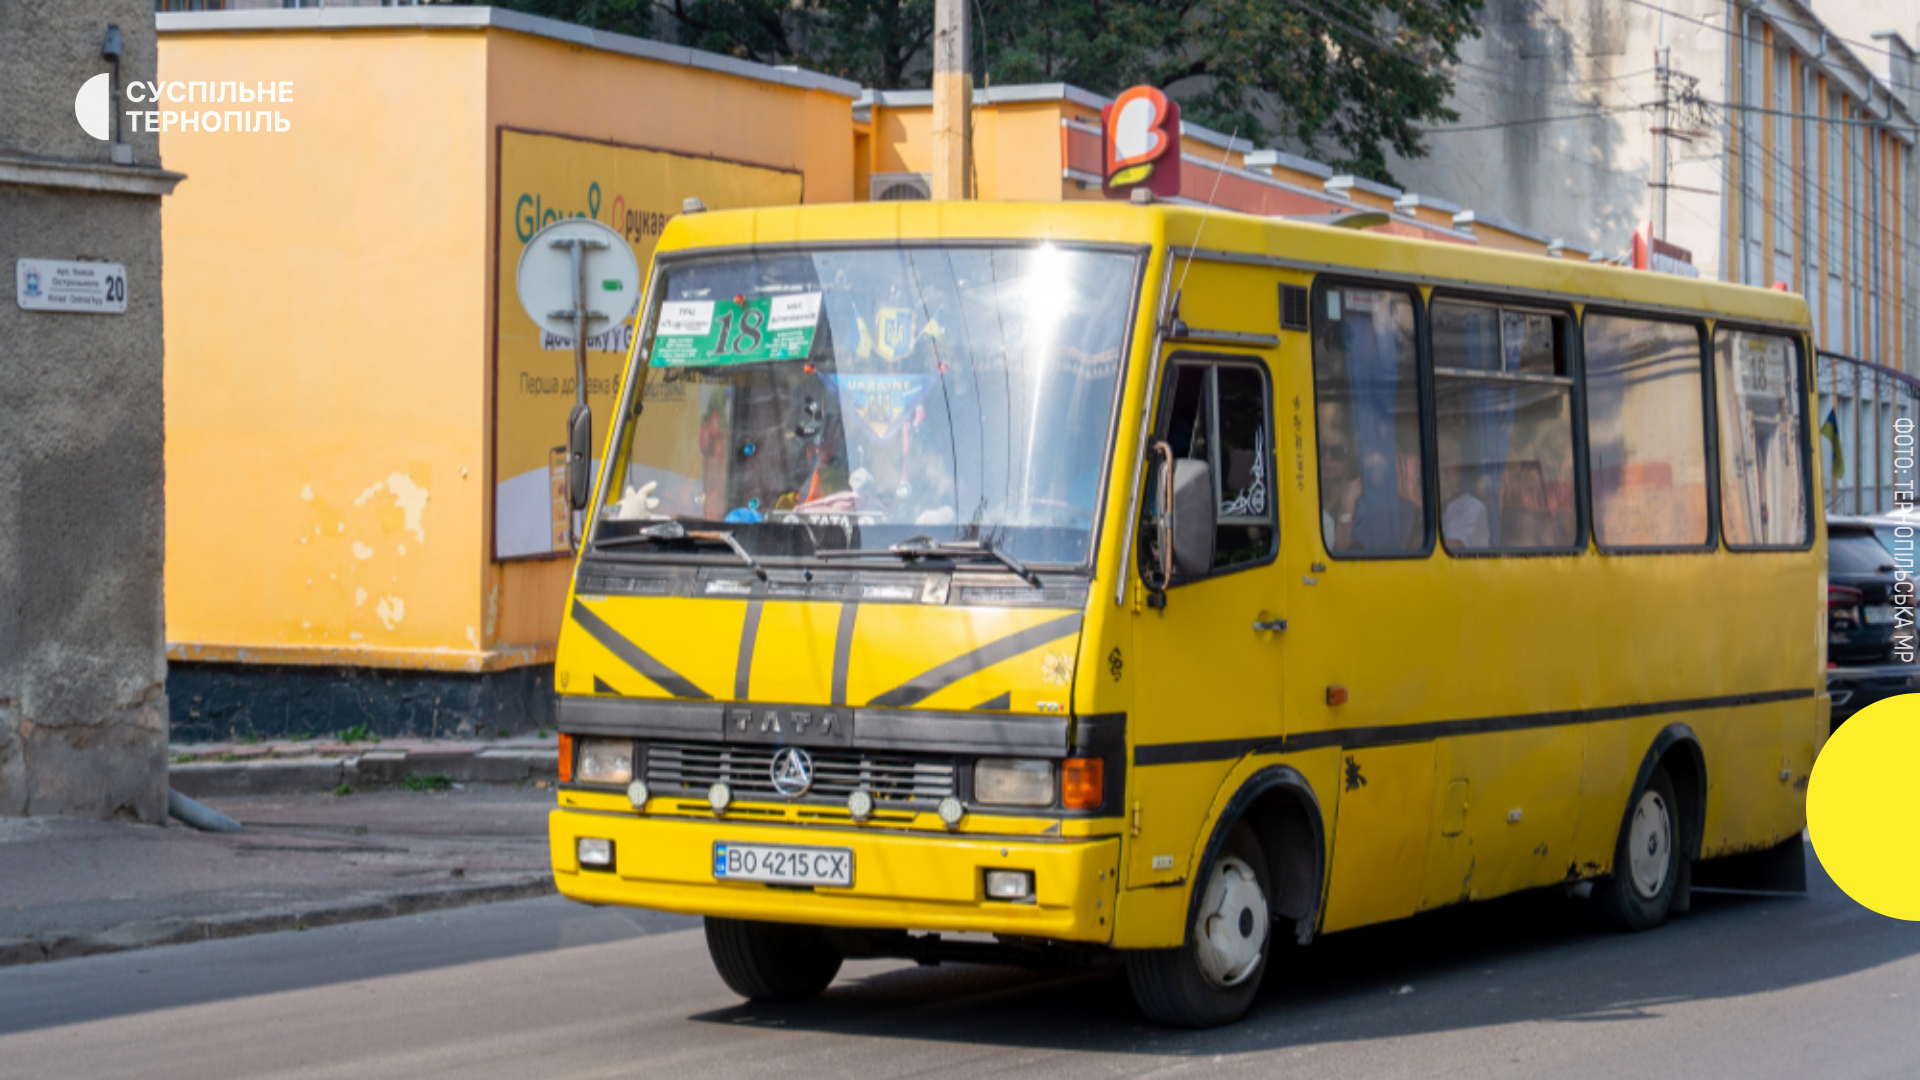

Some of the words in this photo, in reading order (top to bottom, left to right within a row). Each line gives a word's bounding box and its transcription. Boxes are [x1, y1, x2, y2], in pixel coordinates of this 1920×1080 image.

[105, 275, 124, 302] 20
[707, 309, 765, 357] 18
[520, 372, 559, 396] Перша
[848, 381, 910, 391] UKRAINE
[731, 708, 845, 739] TATA
[728, 850, 757, 873] BO
[762, 851, 809, 877] 4215
[814, 855, 844, 879] CX
